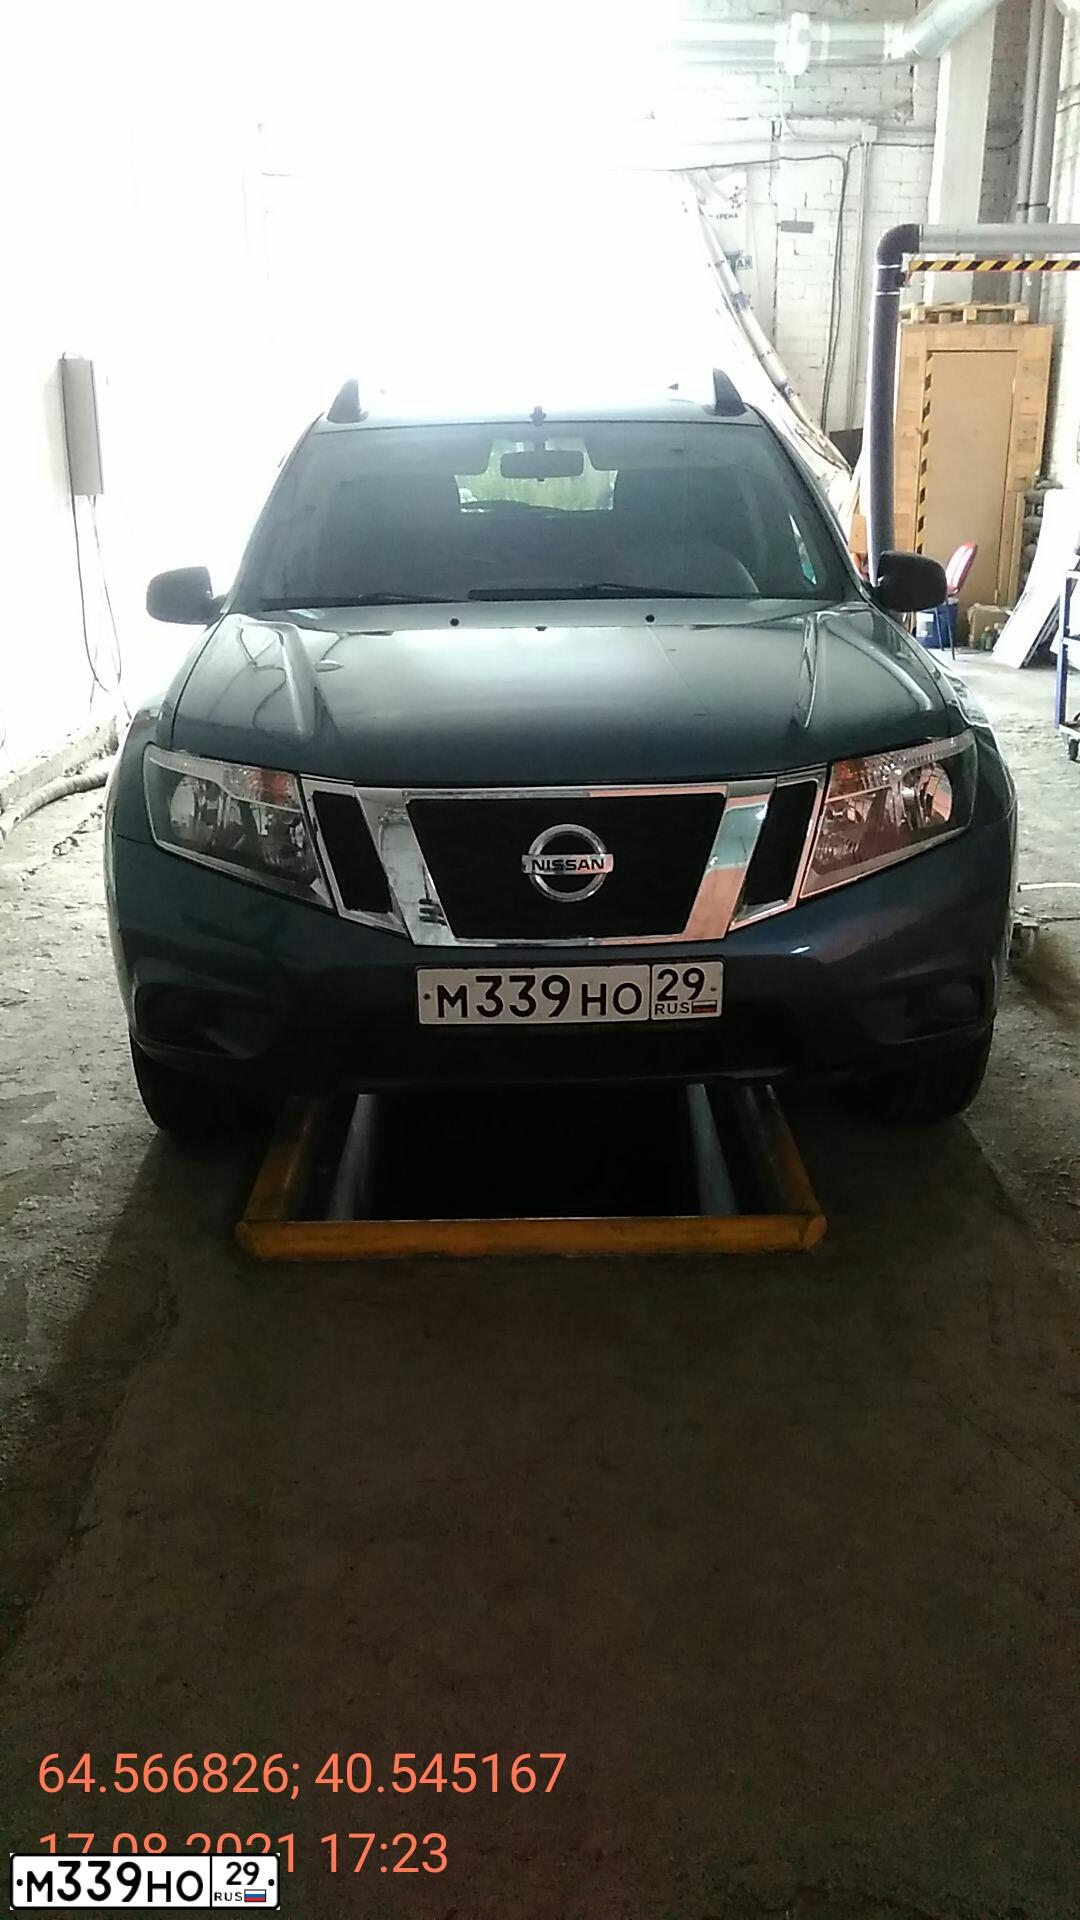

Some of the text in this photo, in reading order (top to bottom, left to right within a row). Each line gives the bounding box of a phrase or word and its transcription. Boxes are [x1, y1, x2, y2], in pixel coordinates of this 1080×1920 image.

[531, 859, 605, 871] NISSAN
[436, 974, 643, 1018] М339НО
[657, 967, 706, 1001] 29
[654, 1001, 690, 1015] RUS
